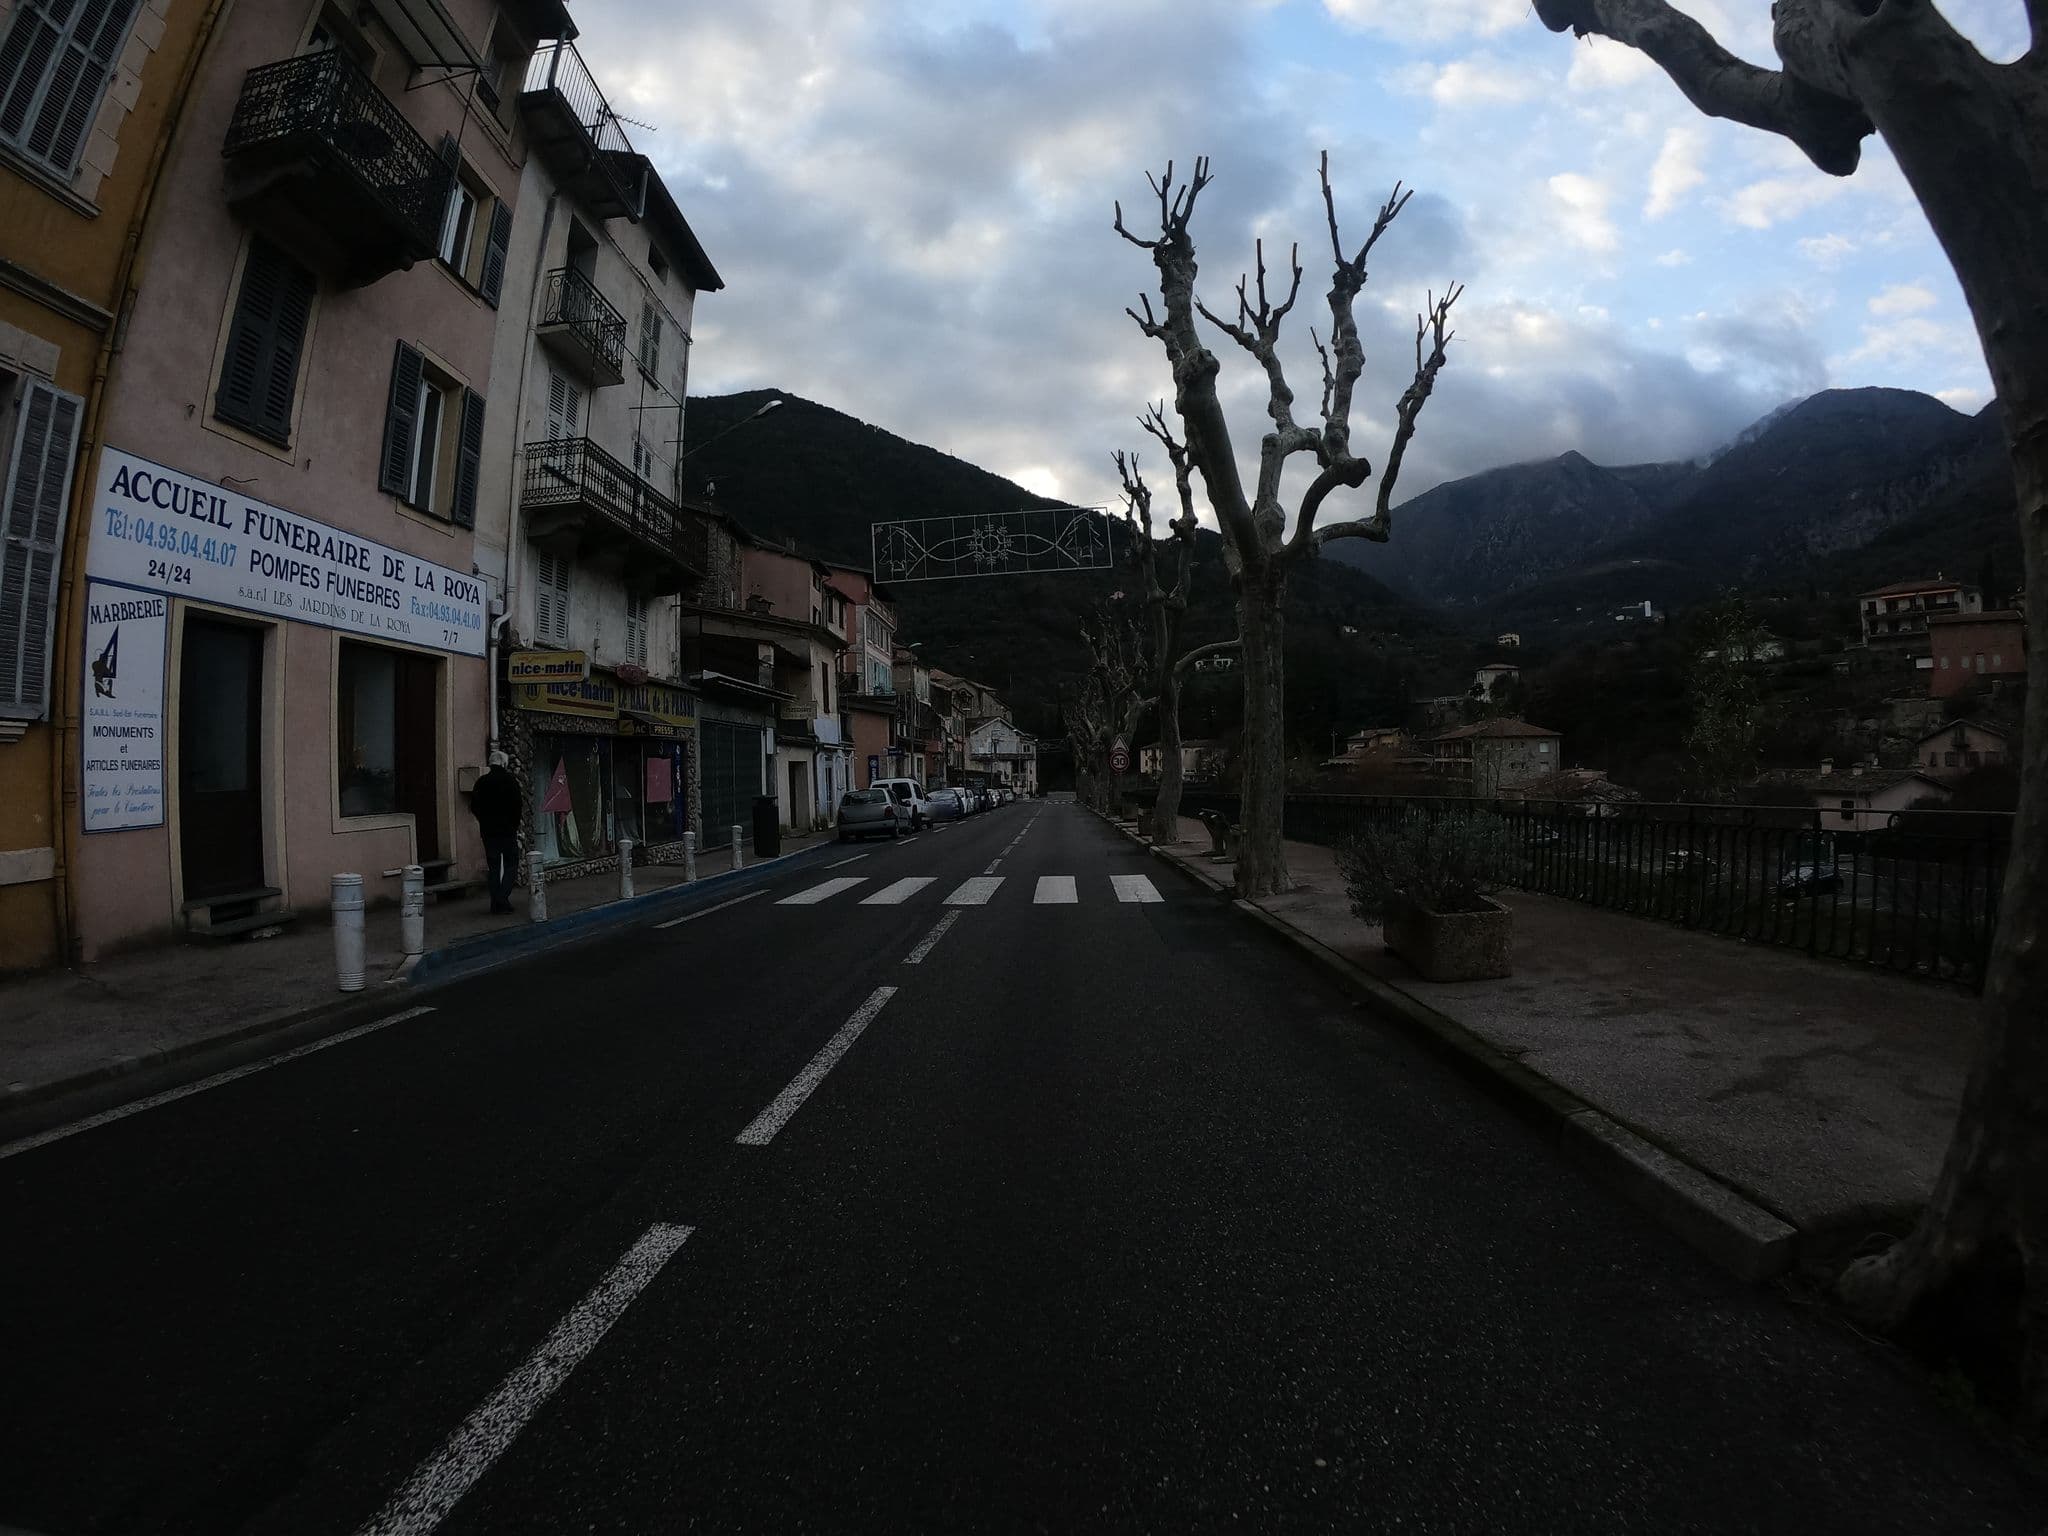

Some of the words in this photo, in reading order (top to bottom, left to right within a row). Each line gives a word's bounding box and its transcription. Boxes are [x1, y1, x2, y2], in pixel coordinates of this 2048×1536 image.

[109, 465, 233, 529] ACCUEIL
[243, 507, 371, 572] FUNERAIRE
[382, 554, 406, 582] DE
[414, 566, 435, 592] LA
[444, 576, 481, 605] ROYA
[148, 559, 192, 585] 24/24
[250, 549, 320, 589] POMPES
[326, 571, 401, 610] FUNEBRES
[90, 598, 164, 624] MARBRERIE
[273, 590, 293, 608] LES
[300, 597, 347, 620] JARDINS
[351, 609, 364, 624] DE
[370, 613, 381, 627] LA
[387, 617, 411, 634] ROYA
[443, 629, 458, 645] 7/7
[93, 725, 154, 739] MONUMENTS
[120, 744, 128, 754] et
[86, 759, 119, 771] ARTICLES
[121, 759, 161, 771] FUNERAIRES
[1113, 757, 1126, 766] 30
